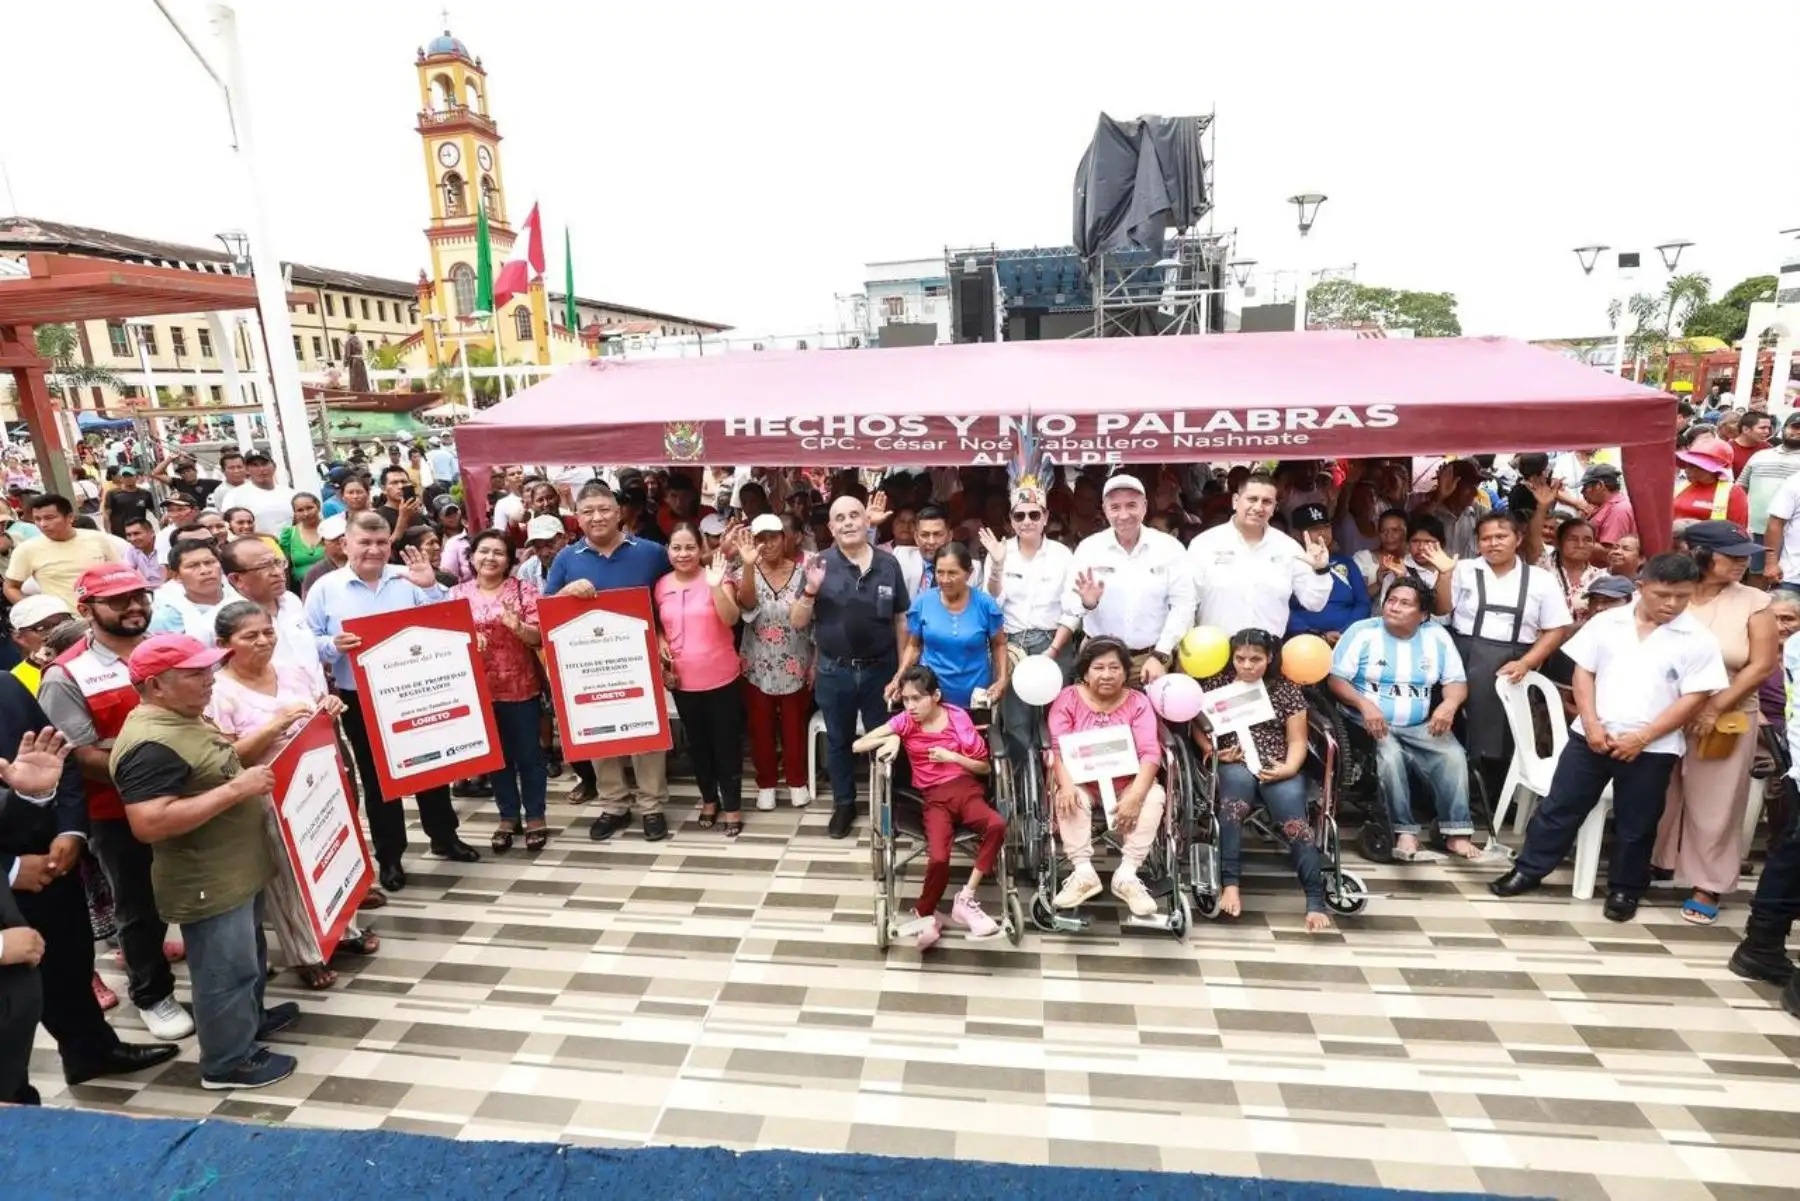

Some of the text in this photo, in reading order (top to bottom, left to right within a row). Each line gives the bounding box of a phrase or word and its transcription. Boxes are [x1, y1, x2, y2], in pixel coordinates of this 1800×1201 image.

[724, 403, 1400, 437] HECHOS Y NO PALABRAS
[800, 431, 1310, 451] CPC. César Noé aballero Nashnate
[971, 452, 1123, 464] ALALDE
[592, 691, 626, 701] LORETO
[411, 711, 450, 727] LORETO
